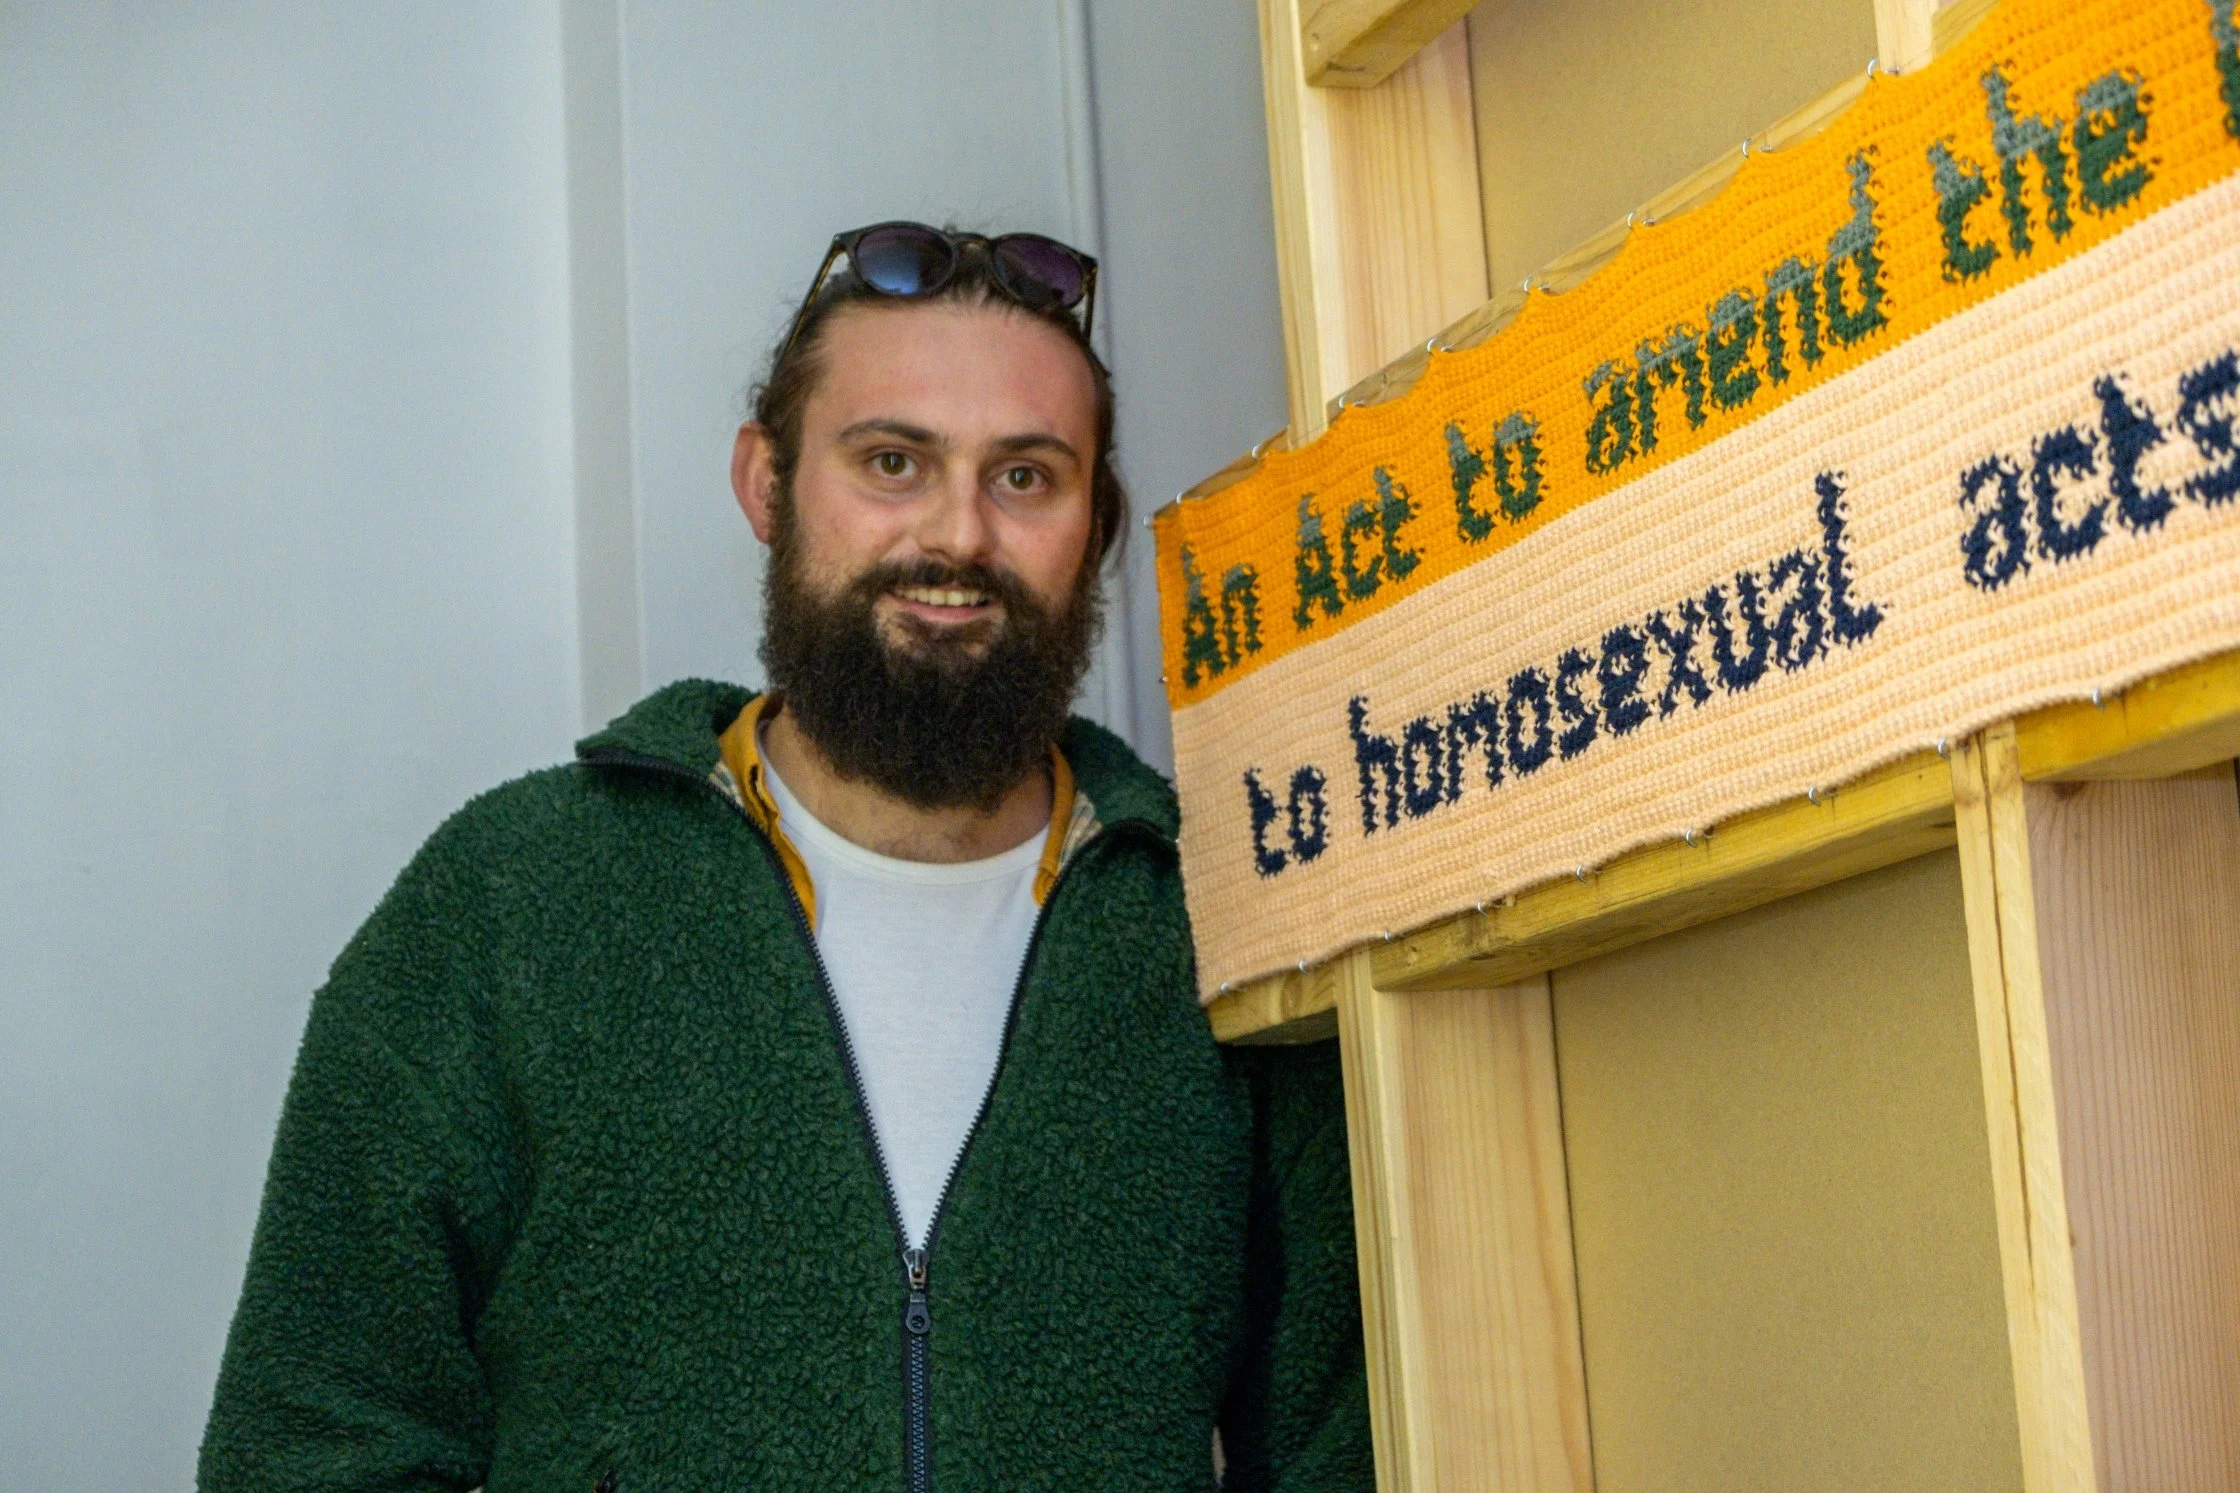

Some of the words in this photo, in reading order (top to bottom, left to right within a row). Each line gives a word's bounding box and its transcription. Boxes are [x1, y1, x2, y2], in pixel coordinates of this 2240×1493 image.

[1181, 542, 1262, 688] An
[1294, 463, 1427, 630] Act
[1444, 409, 1549, 544] to
[1583, 145, 1892, 476] amend
[1926, 60, 2156, 287] the
[1244, 764, 1330, 879] to
[1348, 469, 1886, 838] homosexual
[1959, 346, 2240, 591] acts
